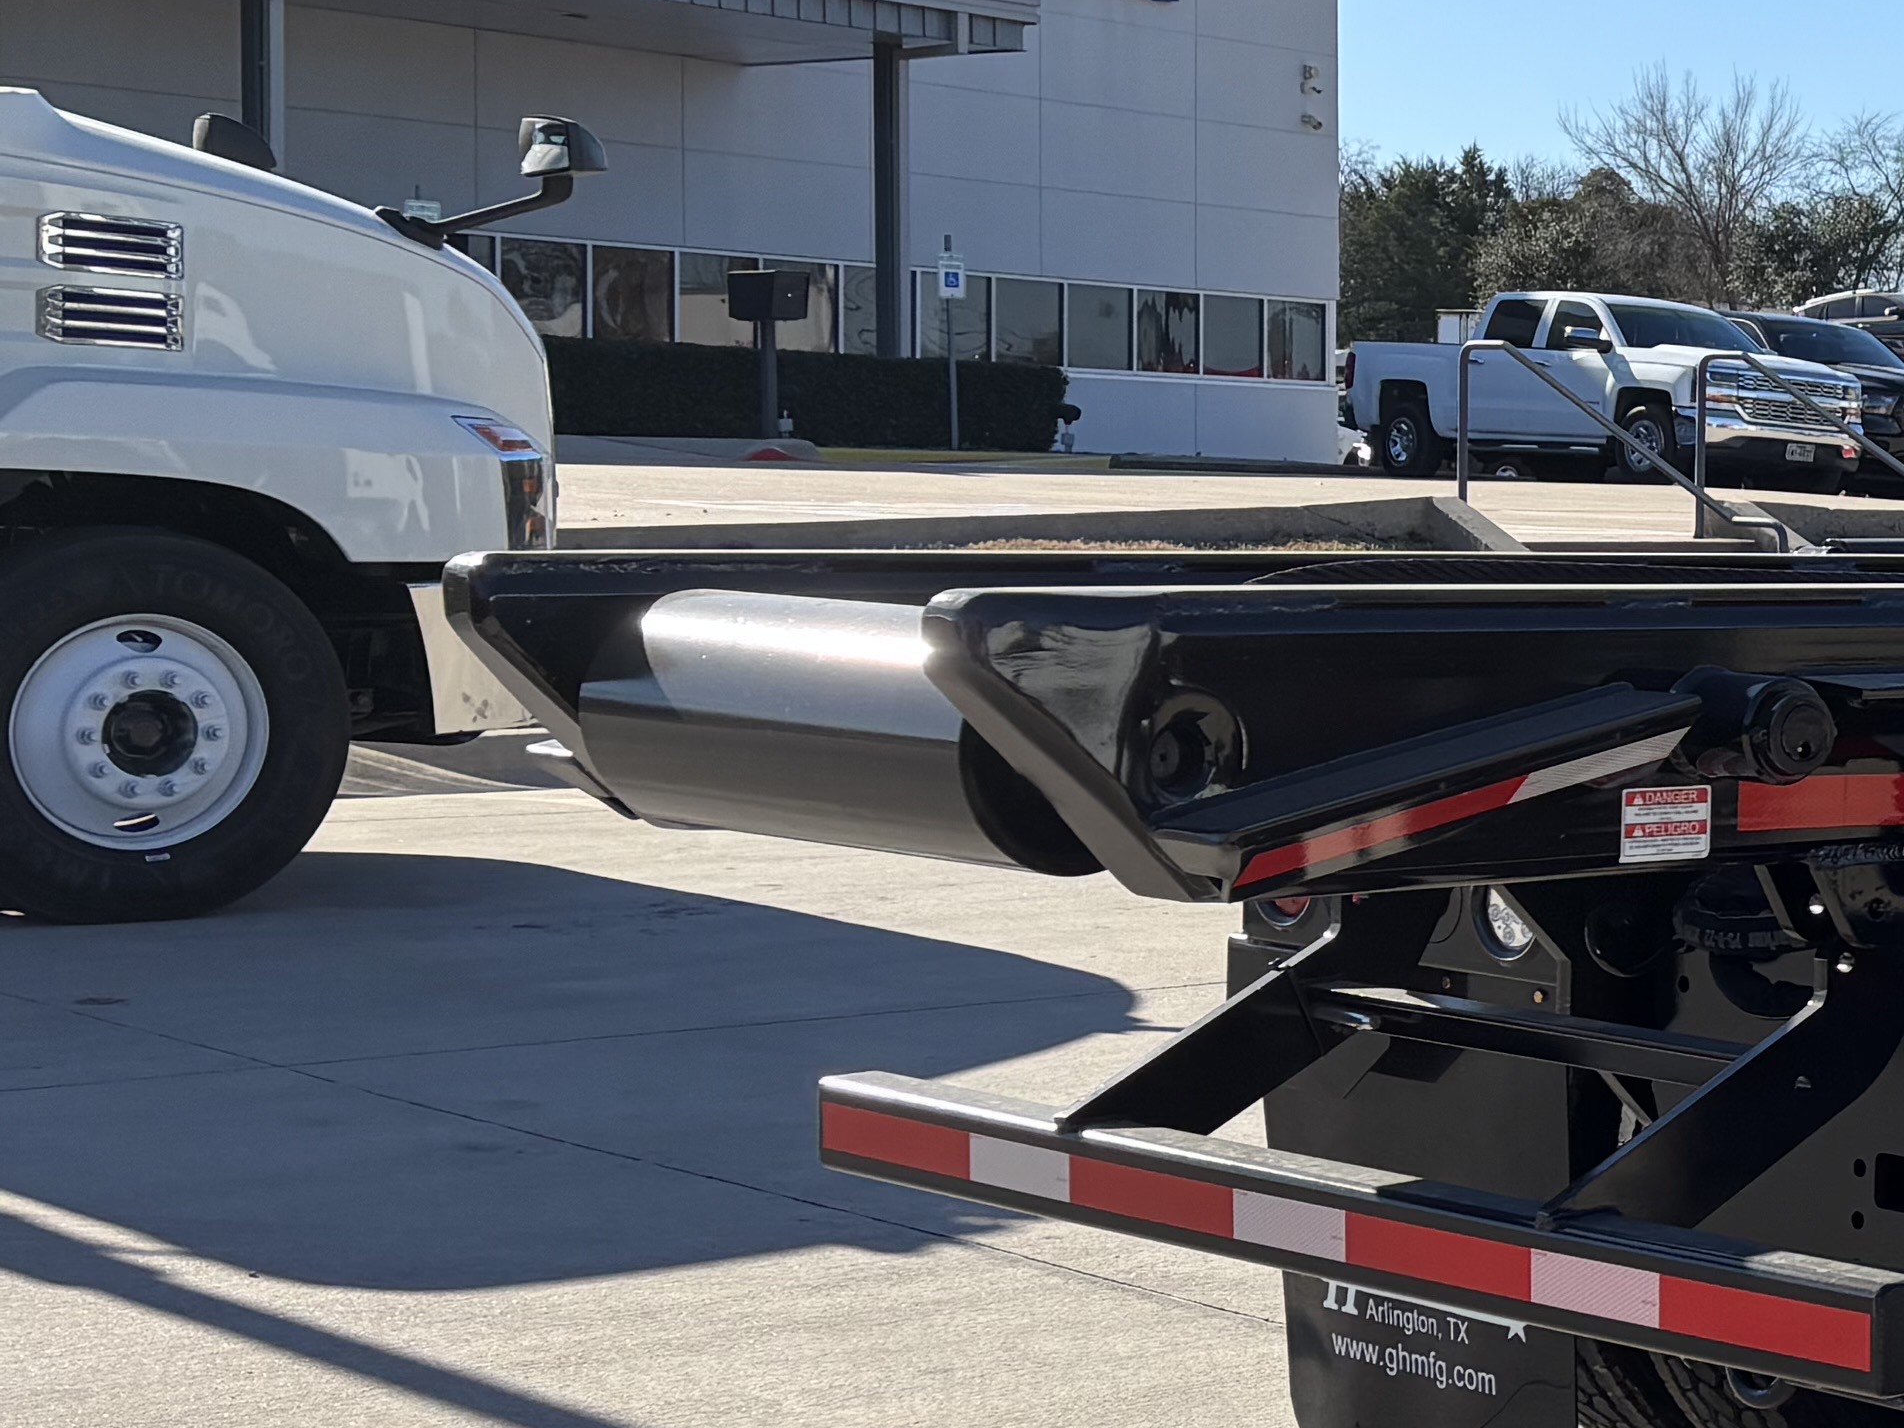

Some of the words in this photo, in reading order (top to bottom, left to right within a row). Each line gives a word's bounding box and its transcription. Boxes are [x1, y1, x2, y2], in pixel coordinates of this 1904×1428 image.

[1645, 789, 1698, 804] DANGER
[1644, 821, 1700, 836] PELIGRO
[1365, 1297, 1443, 1341] Arlington,
[1447, 1316, 1470, 1346] TX
[1331, 1332, 1497, 1397] www.ghmfg.com
